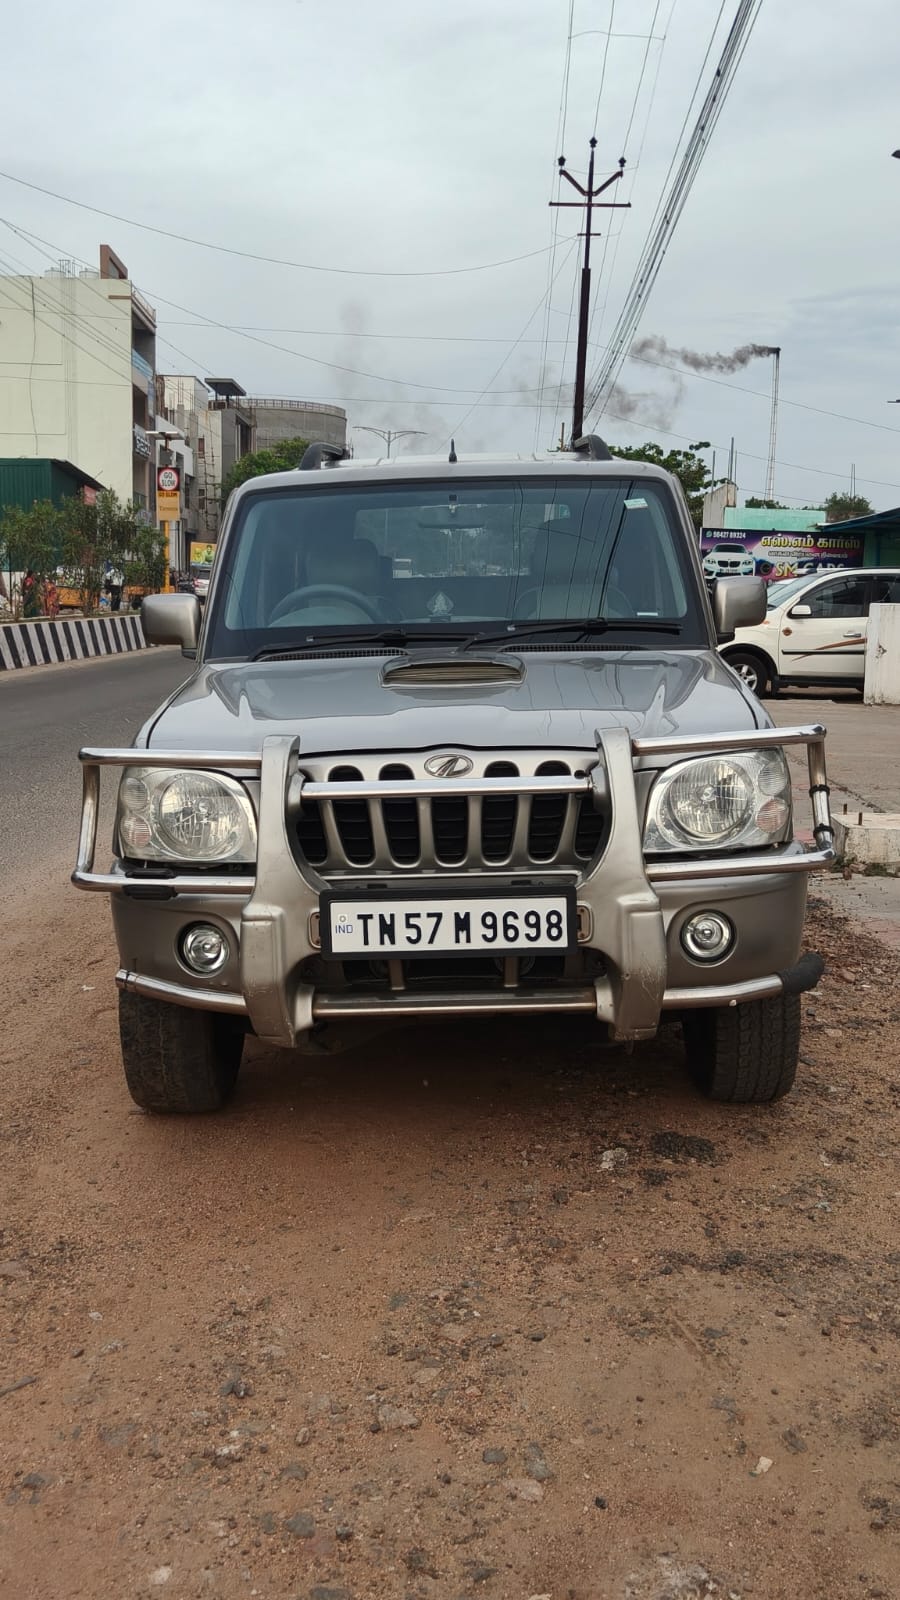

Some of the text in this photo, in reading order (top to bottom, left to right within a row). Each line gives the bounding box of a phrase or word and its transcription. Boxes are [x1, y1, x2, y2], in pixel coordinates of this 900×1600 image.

[775, 561, 799, 577] SM
[335, 925, 353, 934] IND
[357, 909, 563, 946] TN 57 M 9698
